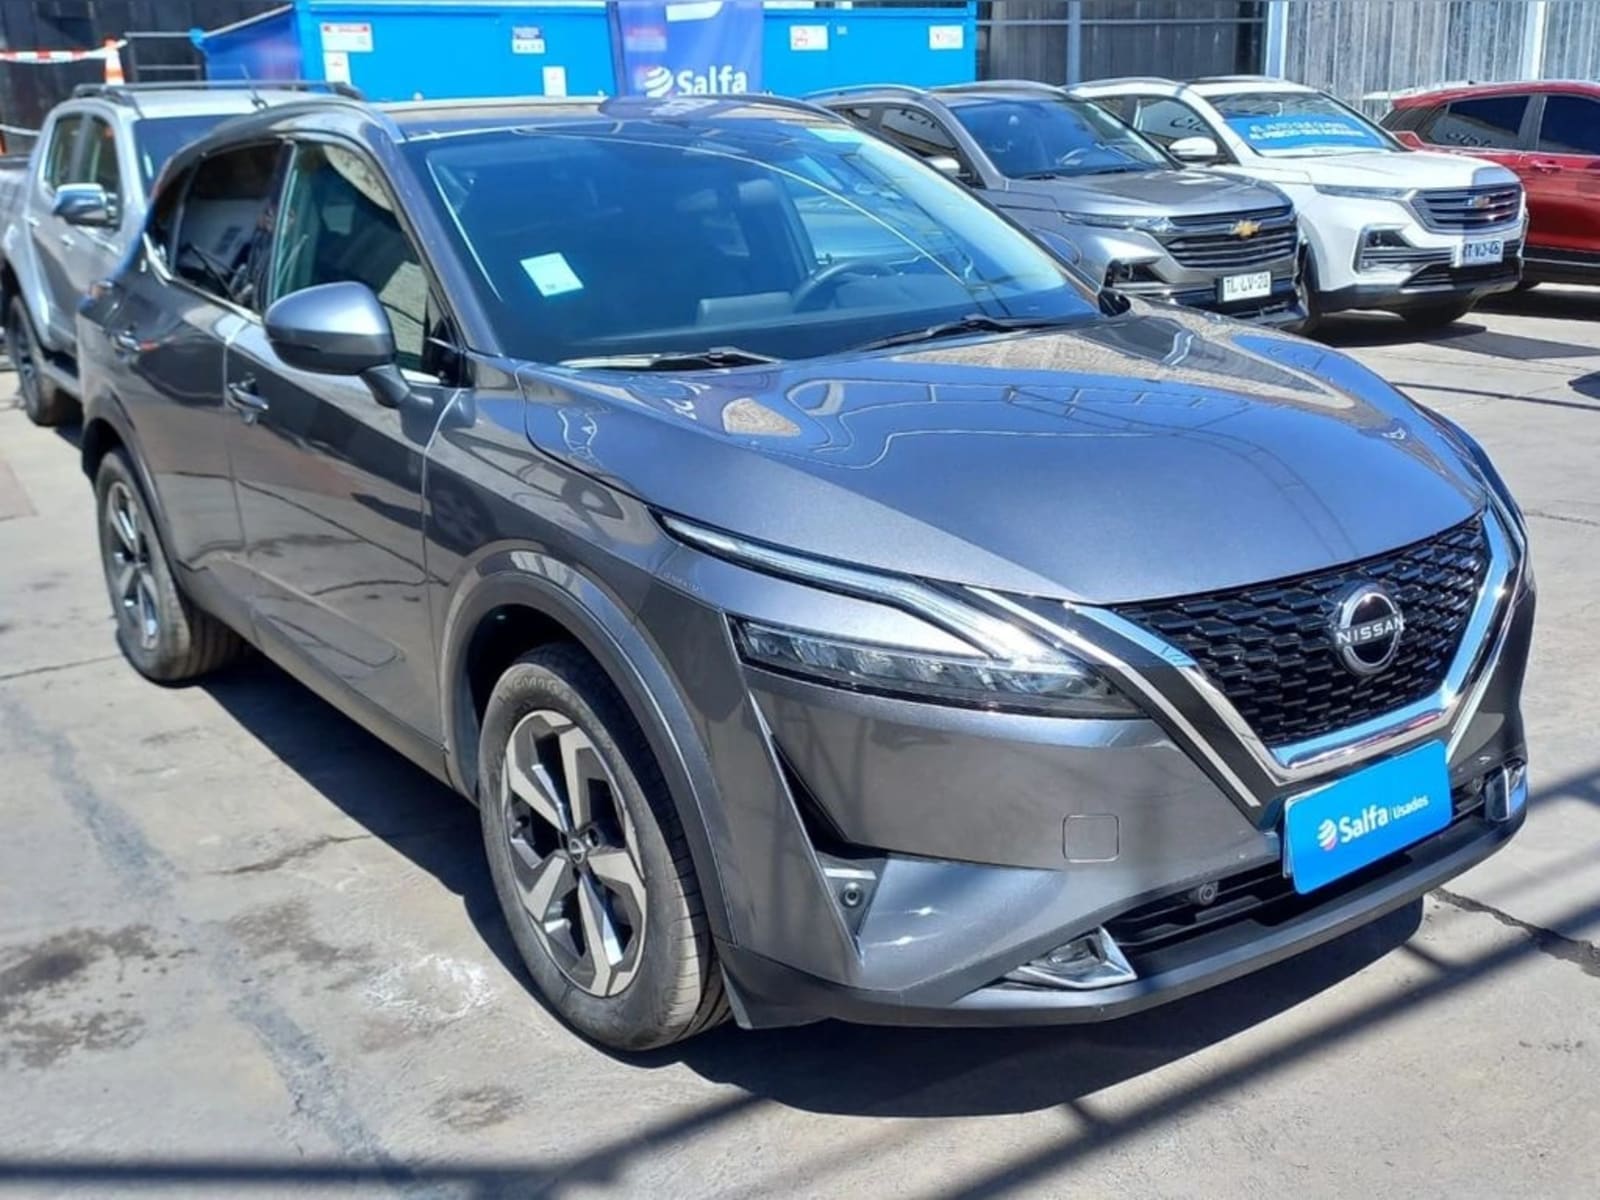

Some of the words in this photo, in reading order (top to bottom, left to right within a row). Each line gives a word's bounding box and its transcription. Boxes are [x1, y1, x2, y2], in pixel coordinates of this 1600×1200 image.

[677, 64, 748, 95] Salfa
[1336, 615, 1405, 644] NISSAN
[1338, 804, 1389, 844] Salfa
[1392, 795, 1430, 820] Usados
